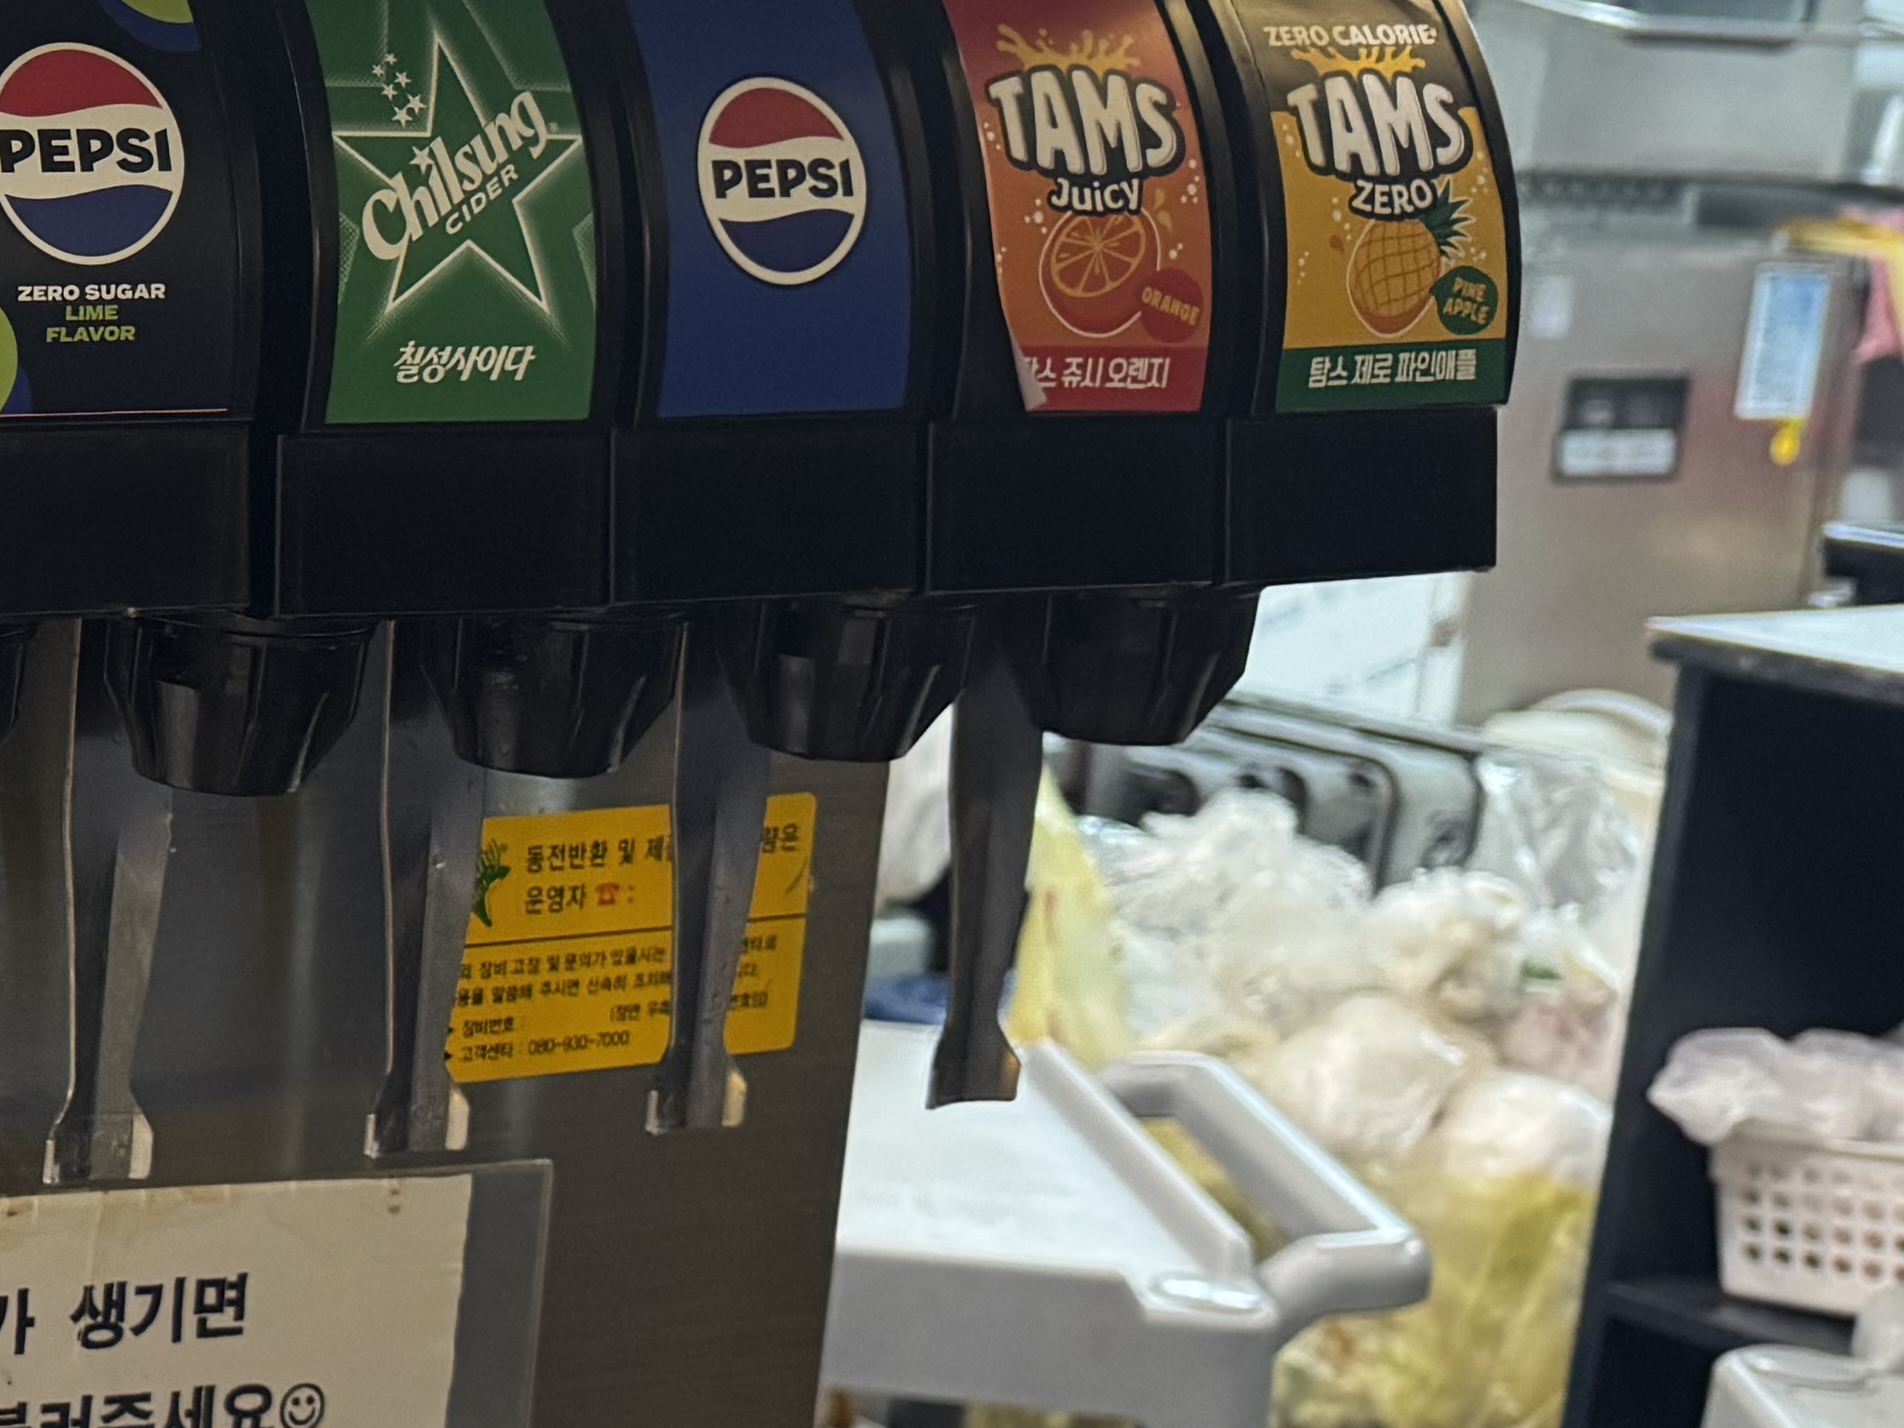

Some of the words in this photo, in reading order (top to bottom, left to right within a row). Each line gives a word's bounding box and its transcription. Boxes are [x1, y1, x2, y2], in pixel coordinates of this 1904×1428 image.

[1264, 26, 1330, 48] ZERO
[1332, 24, 1432, 48] CALORIE
[988, 70, 1179, 174] TAMS
[1287, 74, 1469, 177] TAMS
[362, 91, 550, 260] Chilsung
[712, 158, 853, 199] PEPSI
[445, 164, 519, 235] CIDER
[1350, 179, 1434, 216] ZERO
[17, 285, 82, 302] ZERO
[84, 283, 166, 300] SUGAR
[1141, 285, 1201, 327] ORANGE
[1451, 274, 1486, 304] PINE
[65, 304, 118, 322] LIME
[1442, 295, 1490, 327] APPLE
[46, 325, 135, 343] FLAVOR
[393, 340, 536, 385] 칠성사이다
[1104, 356, 1171, 390] 오렌지
[1308, 355, 1348, 389] 탐스
[1351, 353, 1393, 386] 제로
[1395, 348, 1478, 384] 파인애플
[525, 841, 608, 872] 동전반환
[618, 838, 636, 865] 및
[645, 834, 673, 864] 제
[525, 884, 586, 915] 운영자
[69, 1272, 249, 1350] 생기면
